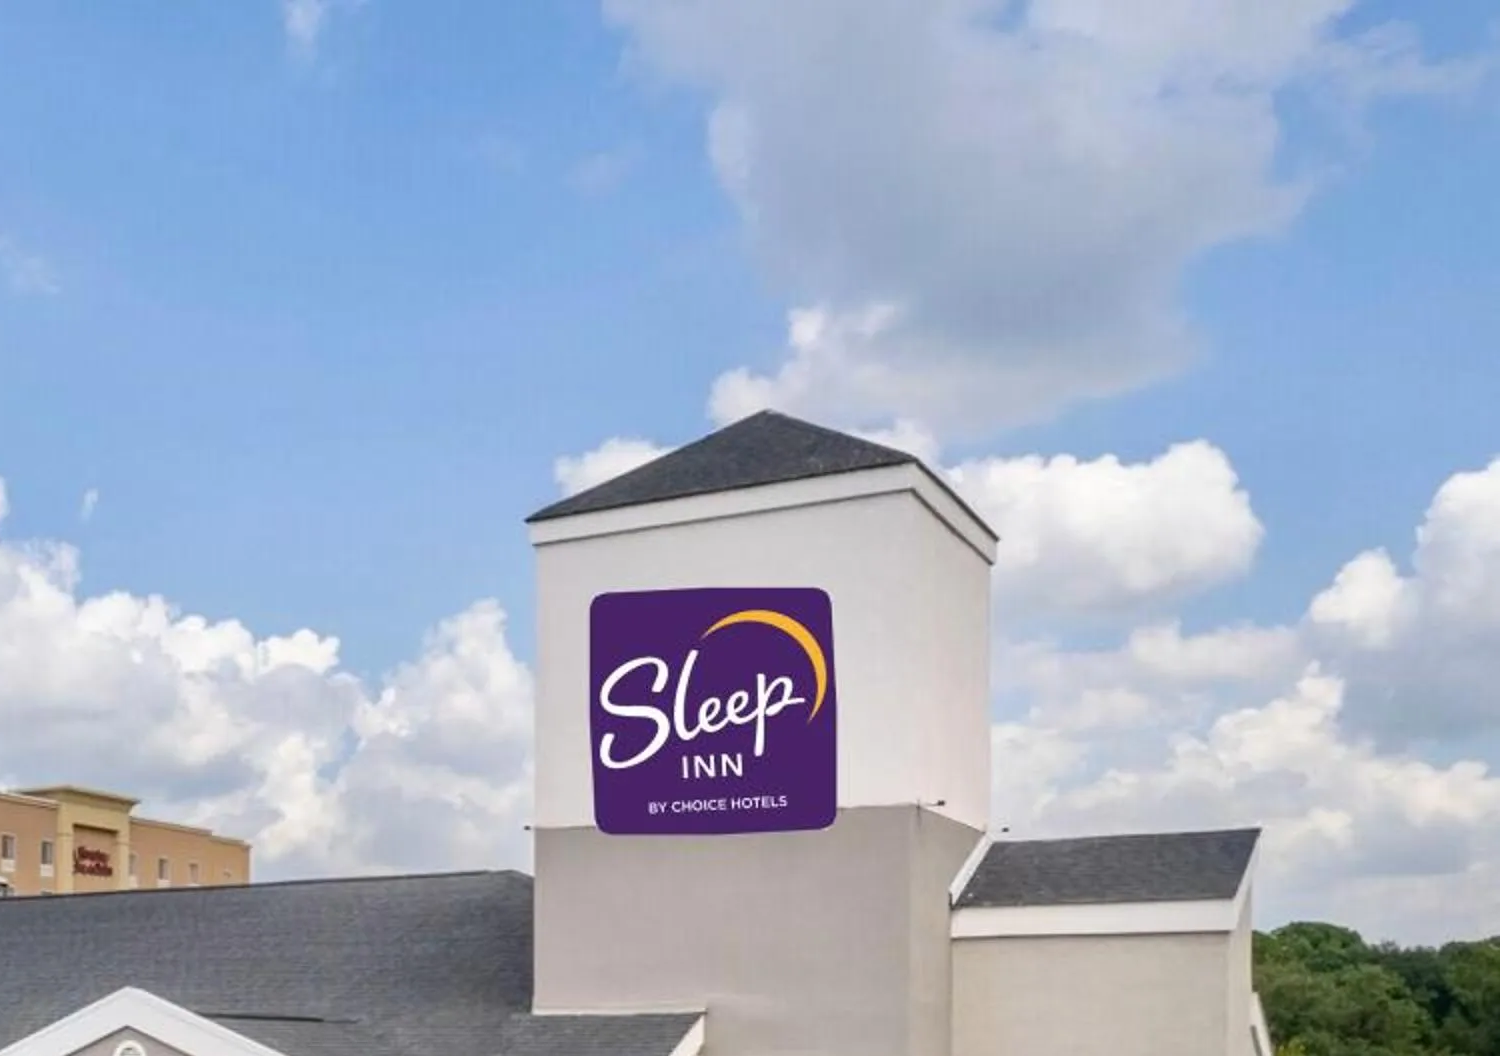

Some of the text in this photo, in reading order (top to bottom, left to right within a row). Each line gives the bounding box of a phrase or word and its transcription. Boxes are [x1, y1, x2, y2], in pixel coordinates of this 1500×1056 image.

[599, 649, 805, 769] Sleep
[682, 752, 743, 779] INN
[648, 795, 788, 815] BY CHOICE HOTELS
